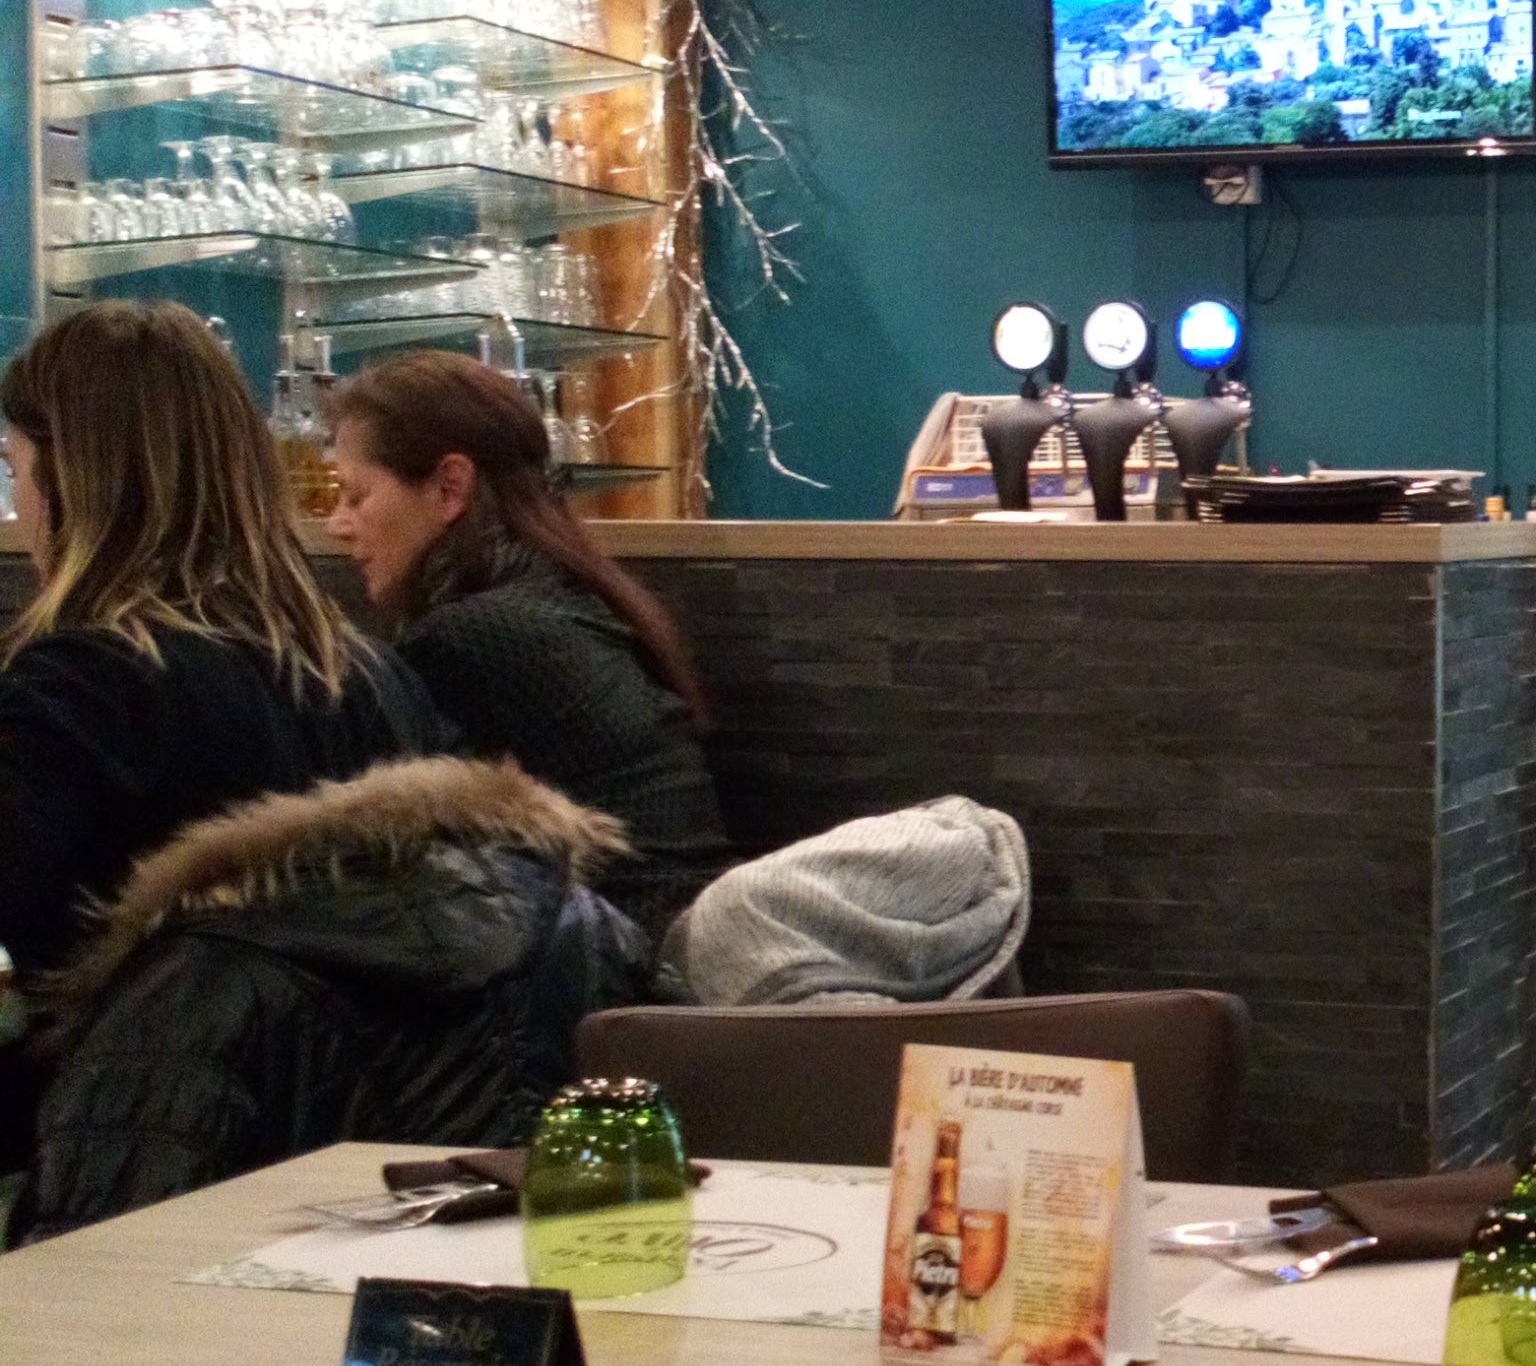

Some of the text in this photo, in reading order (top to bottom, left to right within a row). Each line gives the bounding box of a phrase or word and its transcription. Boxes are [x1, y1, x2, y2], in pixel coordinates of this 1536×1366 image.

[948, 1062, 1084, 1097] LA BIÈRE D'AUTOMNE
